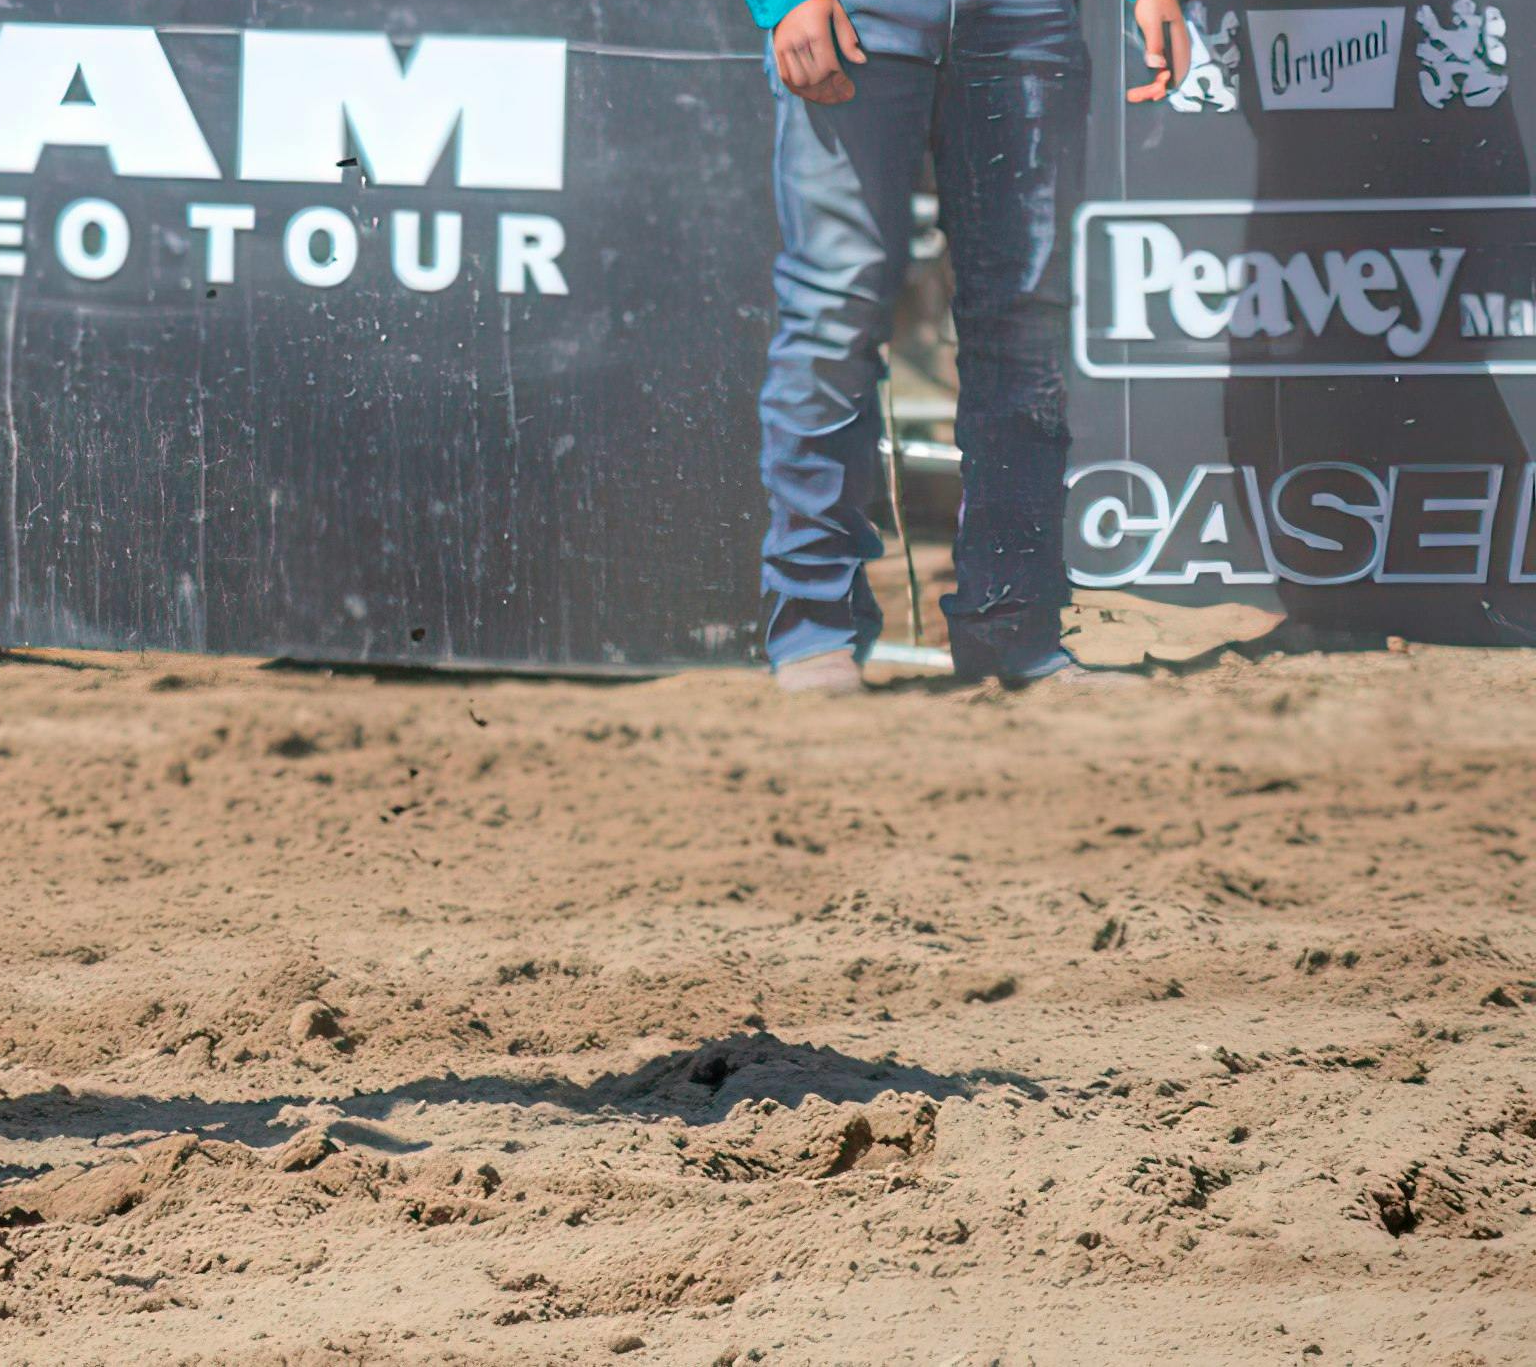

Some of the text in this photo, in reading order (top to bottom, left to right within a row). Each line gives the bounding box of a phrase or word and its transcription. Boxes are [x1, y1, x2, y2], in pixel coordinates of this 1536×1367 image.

[1272, 21, 1388, 97] Original
[188, 200, 571, 296] TOUR
[1103, 219, 1467, 358] Peavey
[1064, 461, 1505, 589] CASE
